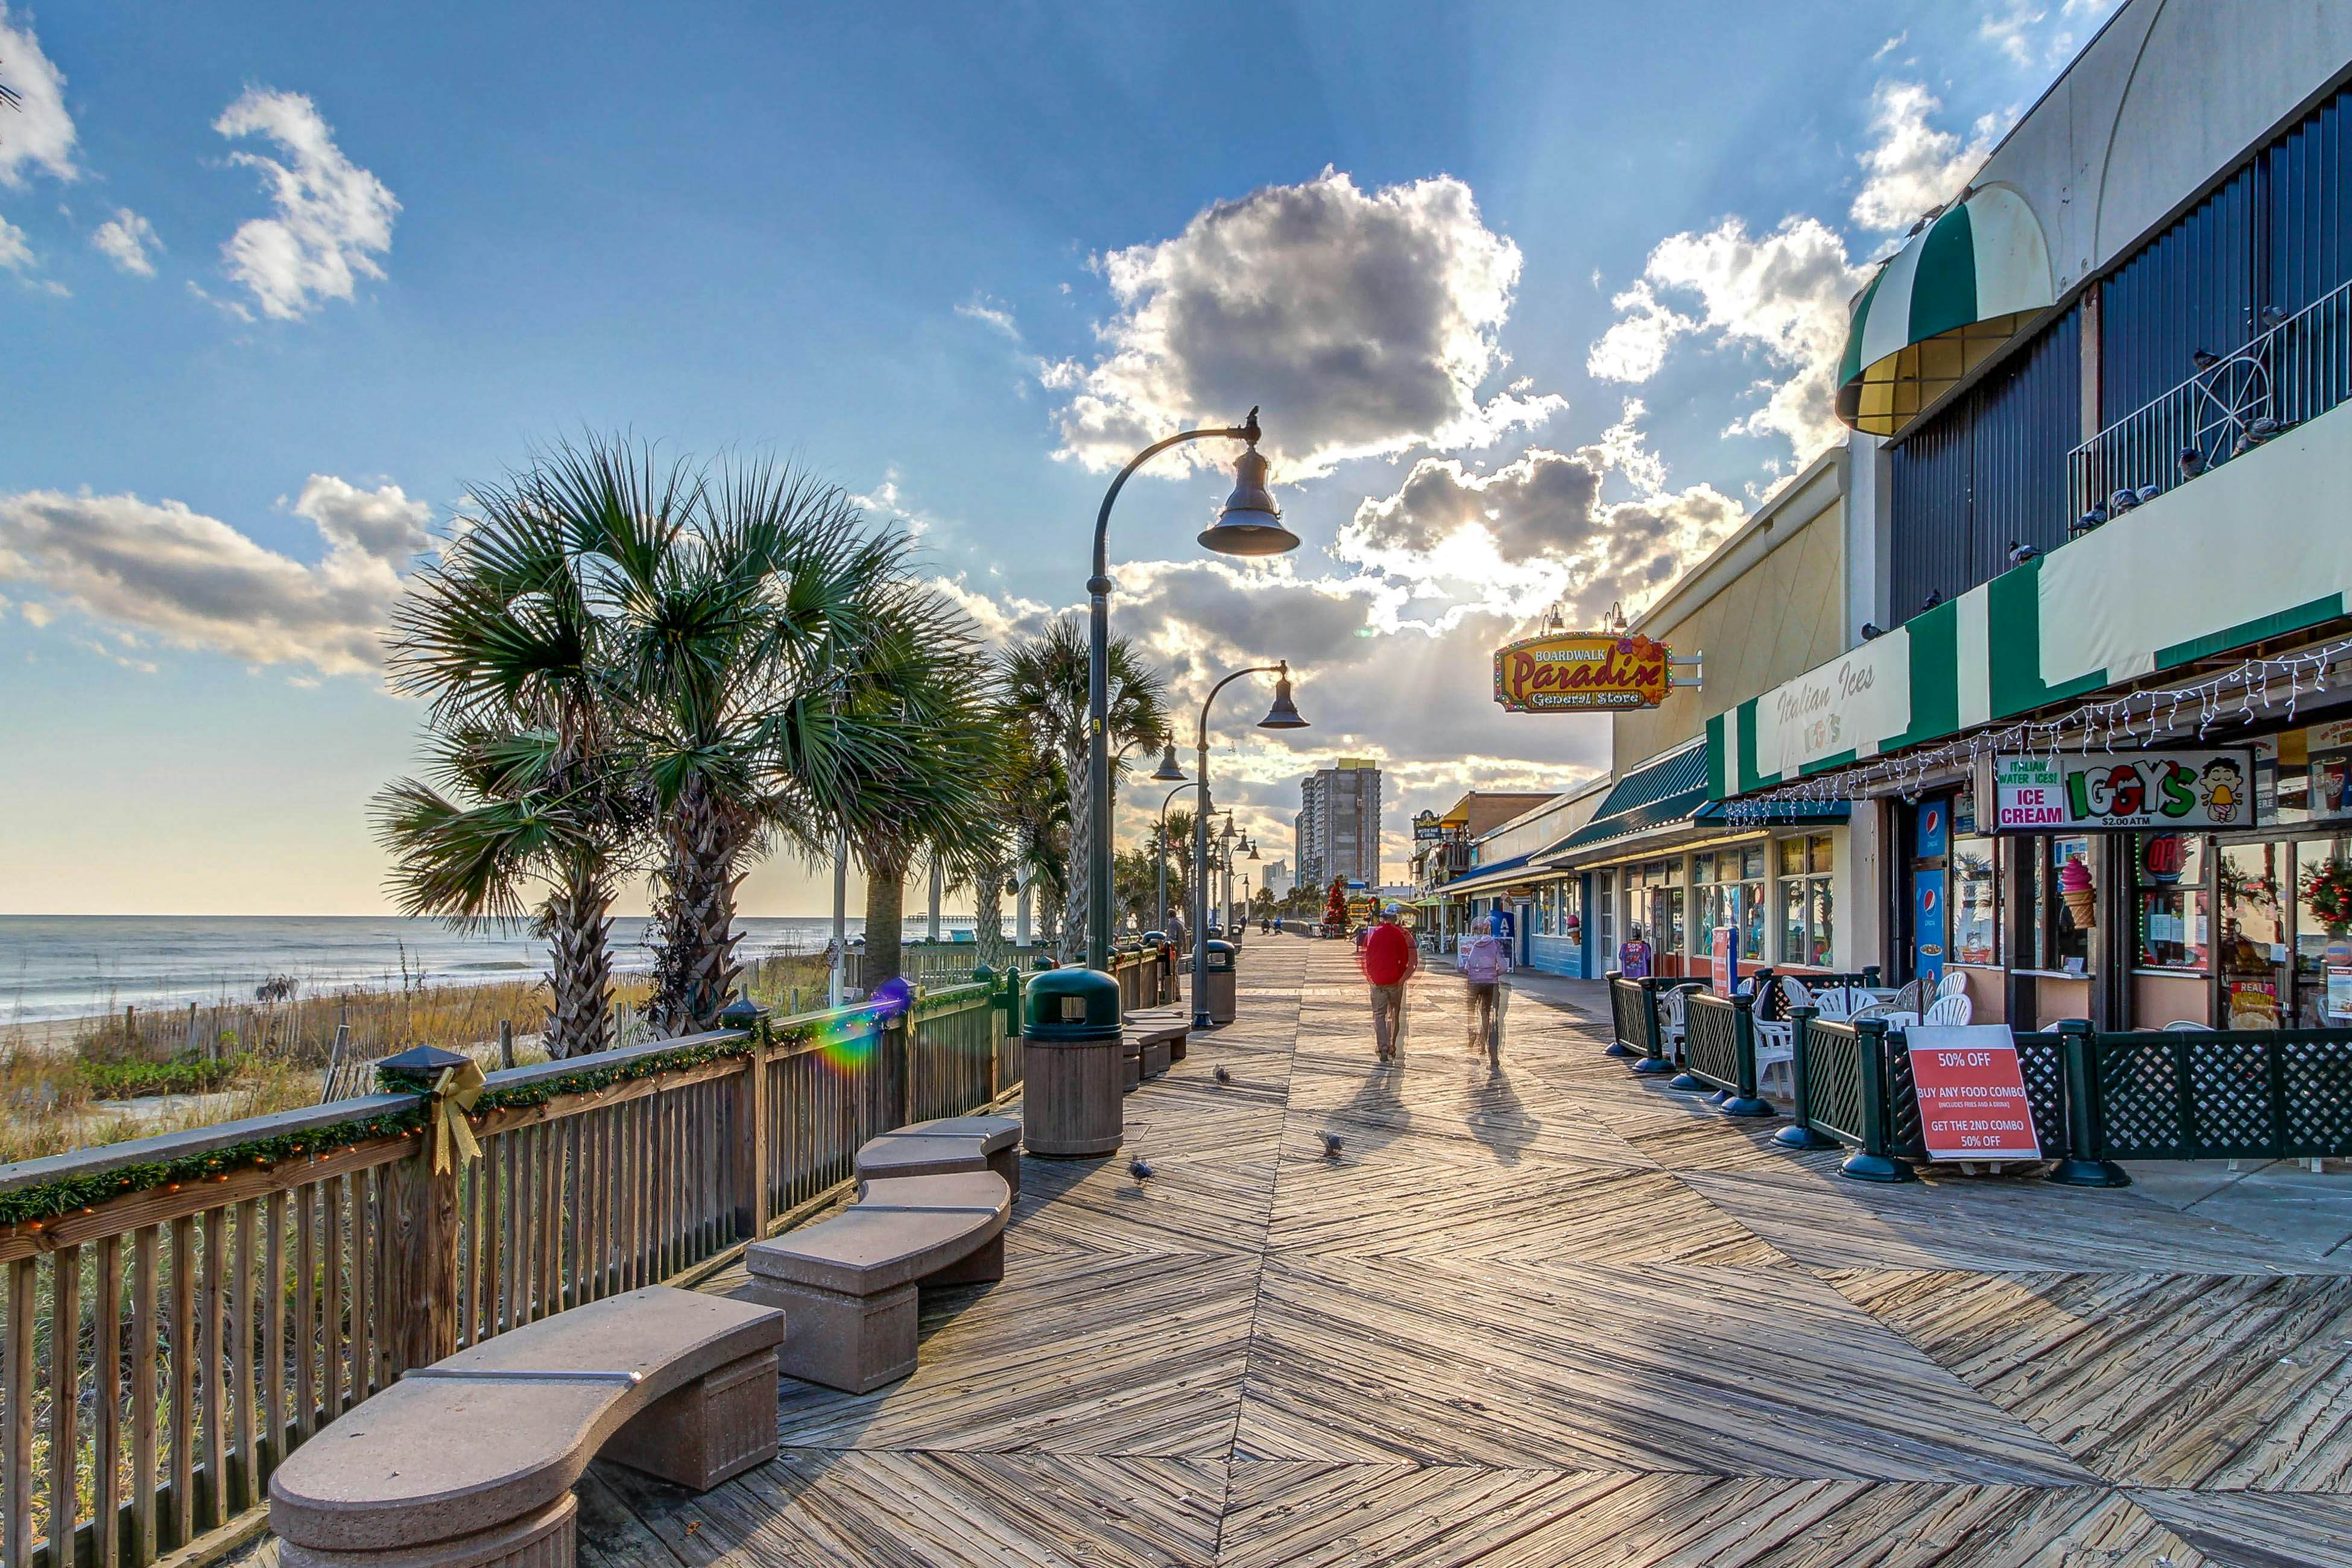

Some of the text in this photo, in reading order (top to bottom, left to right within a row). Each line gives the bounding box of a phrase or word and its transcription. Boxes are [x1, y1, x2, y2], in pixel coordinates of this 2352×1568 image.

[1535, 650, 1606, 662] BOARDWALK
[1513, 644, 1661, 699] Paradise
[1532, 692, 1639, 706] General Store
[1777, 660, 1875, 725] Italian Ices
[2010, 761, 2047, 772] ITALIAN
[1999, 773, 2058, 784] WATER ICES!
[2065, 759, 2199, 822] IGGY'S
[2017, 789, 2045, 806] ICE
[2001, 807, 2063, 824] CREAM
[2102, 817, 2128, 826] $2.00
[1500, 918, 1510, 937] AT
[2240, 982, 2264, 993] REAL
[1938, 1052, 1991, 1067] 50% OFF
[1918, 1086, 2024, 1098] BUY ANY FOOD COMBO
[1931, 1120, 2024, 1132] GET THE 2ND COMBO
[1961, 1136, 2001, 1147] 50% OFF
